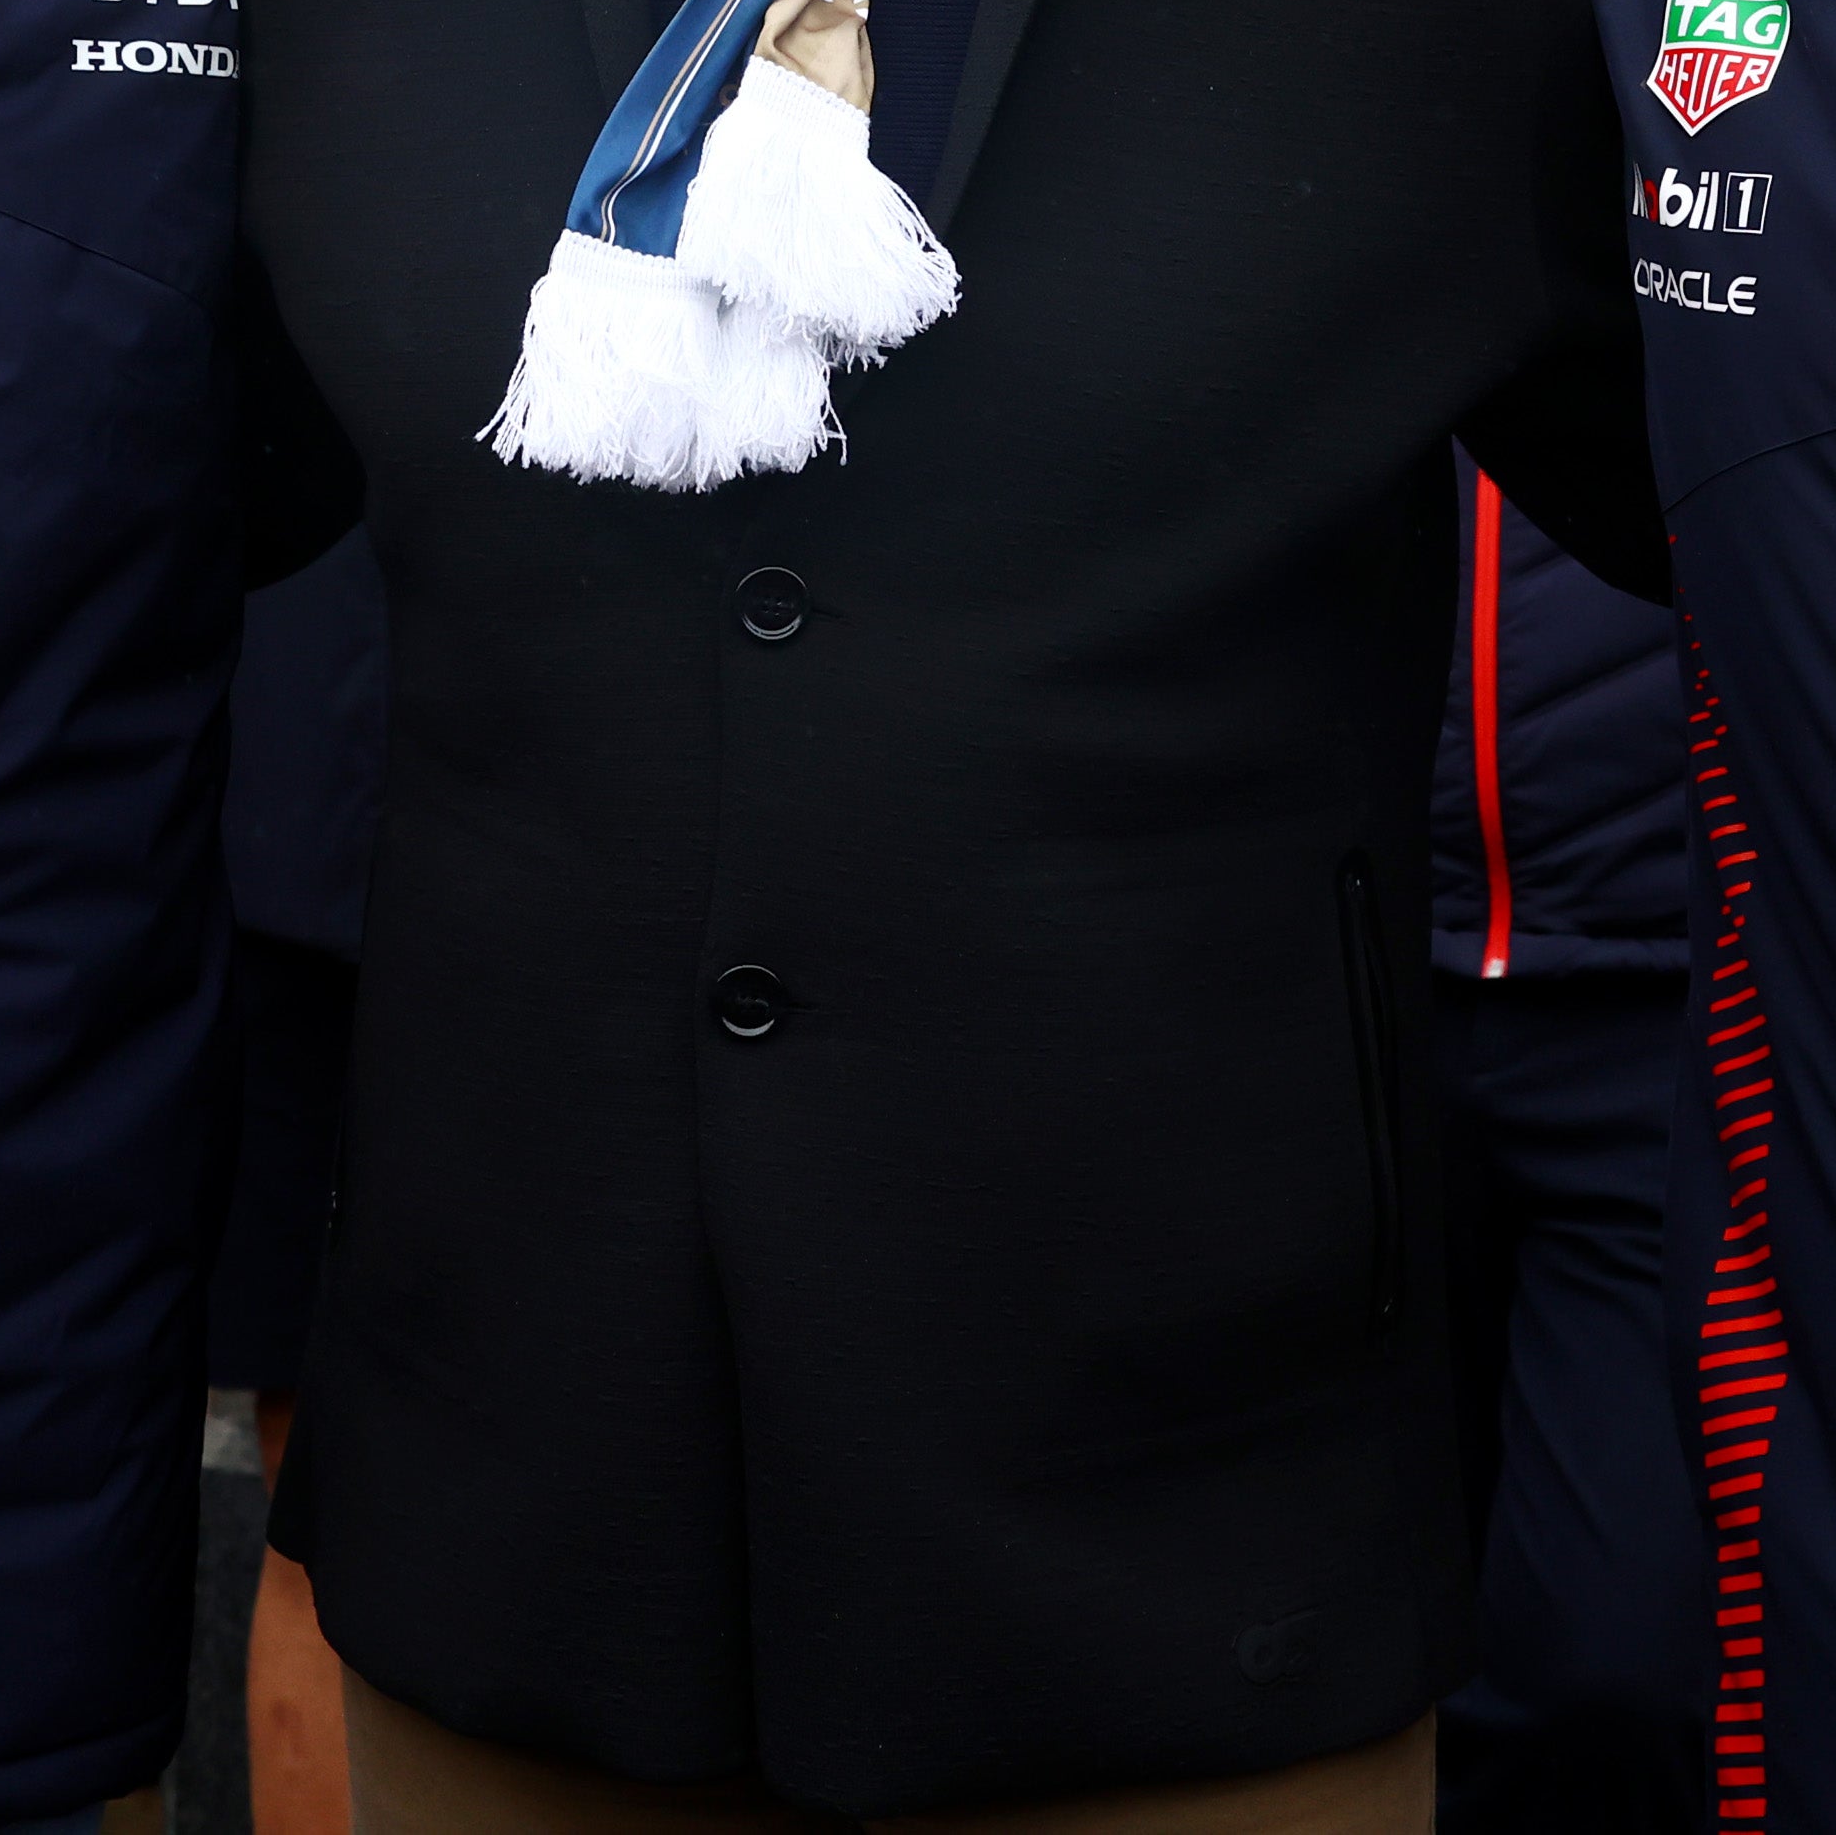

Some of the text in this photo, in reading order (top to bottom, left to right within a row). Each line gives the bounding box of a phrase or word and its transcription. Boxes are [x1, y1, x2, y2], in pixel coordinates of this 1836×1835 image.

[71, 38, 240, 79] HOND
[1660, 53, 1768, 118] HEUER
[1633, 257, 1758, 315] ORACLE
